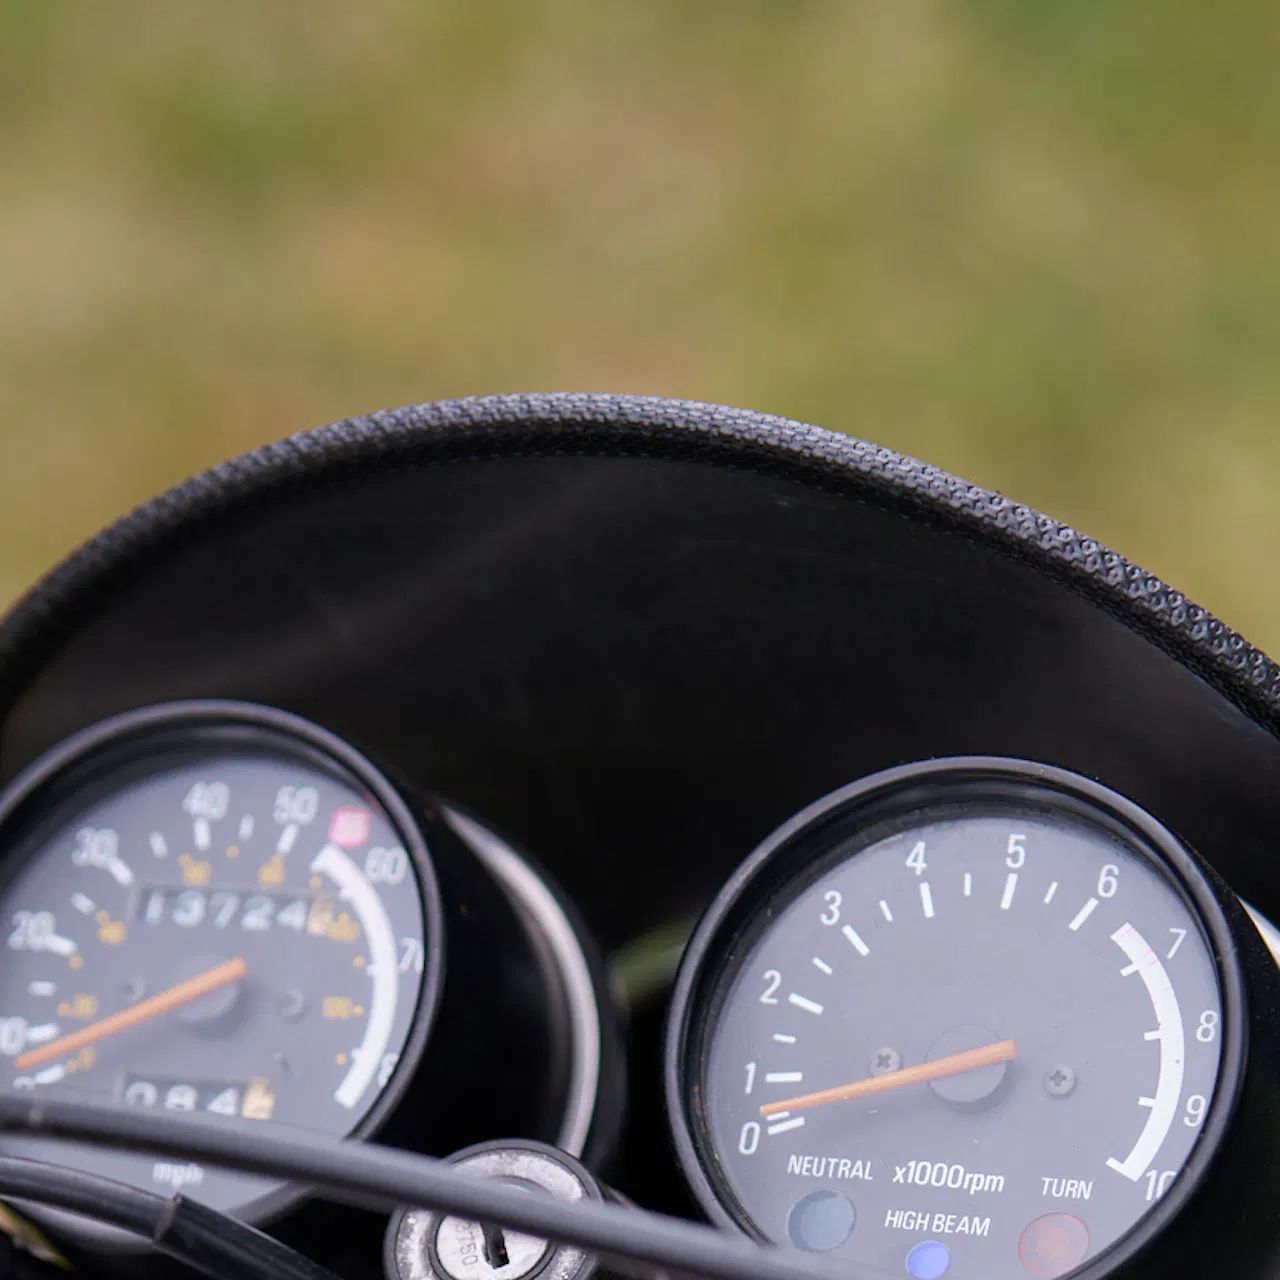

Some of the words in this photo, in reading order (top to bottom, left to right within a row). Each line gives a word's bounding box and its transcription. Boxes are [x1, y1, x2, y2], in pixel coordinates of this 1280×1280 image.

[183, 781, 230, 820] 40
[273, 786, 319, 824] 50
[72, 827, 119, 868] 30
[905, 841, 927, 876] 4
[1006, 834, 1026, 869] 5
[365, 846, 408, 885] 60
[1097, 864, 1119, 898] 6
[820, 890, 842, 926] 3
[9, 909, 56, 951] 20
[1166, 927, 1187, 959] 7
[760, 969, 782, 1004] 2
[1195, 1010, 1218, 1043] 8
[745, 1062, 757, 1094] 1
[1184, 1094, 1206, 1127] 9
[738, 1121, 761, 1155] 0
[152, 1162, 205, 1191] mph
[787, 1154, 874, 1182] NEUTRAL
[892, 1160, 1005, 1195] x1000rpm
[1042, 1177, 1093, 1200] TURN
[884, 1209, 929, 1231] HIGH
[931, 1213, 991, 1237] BEAM
